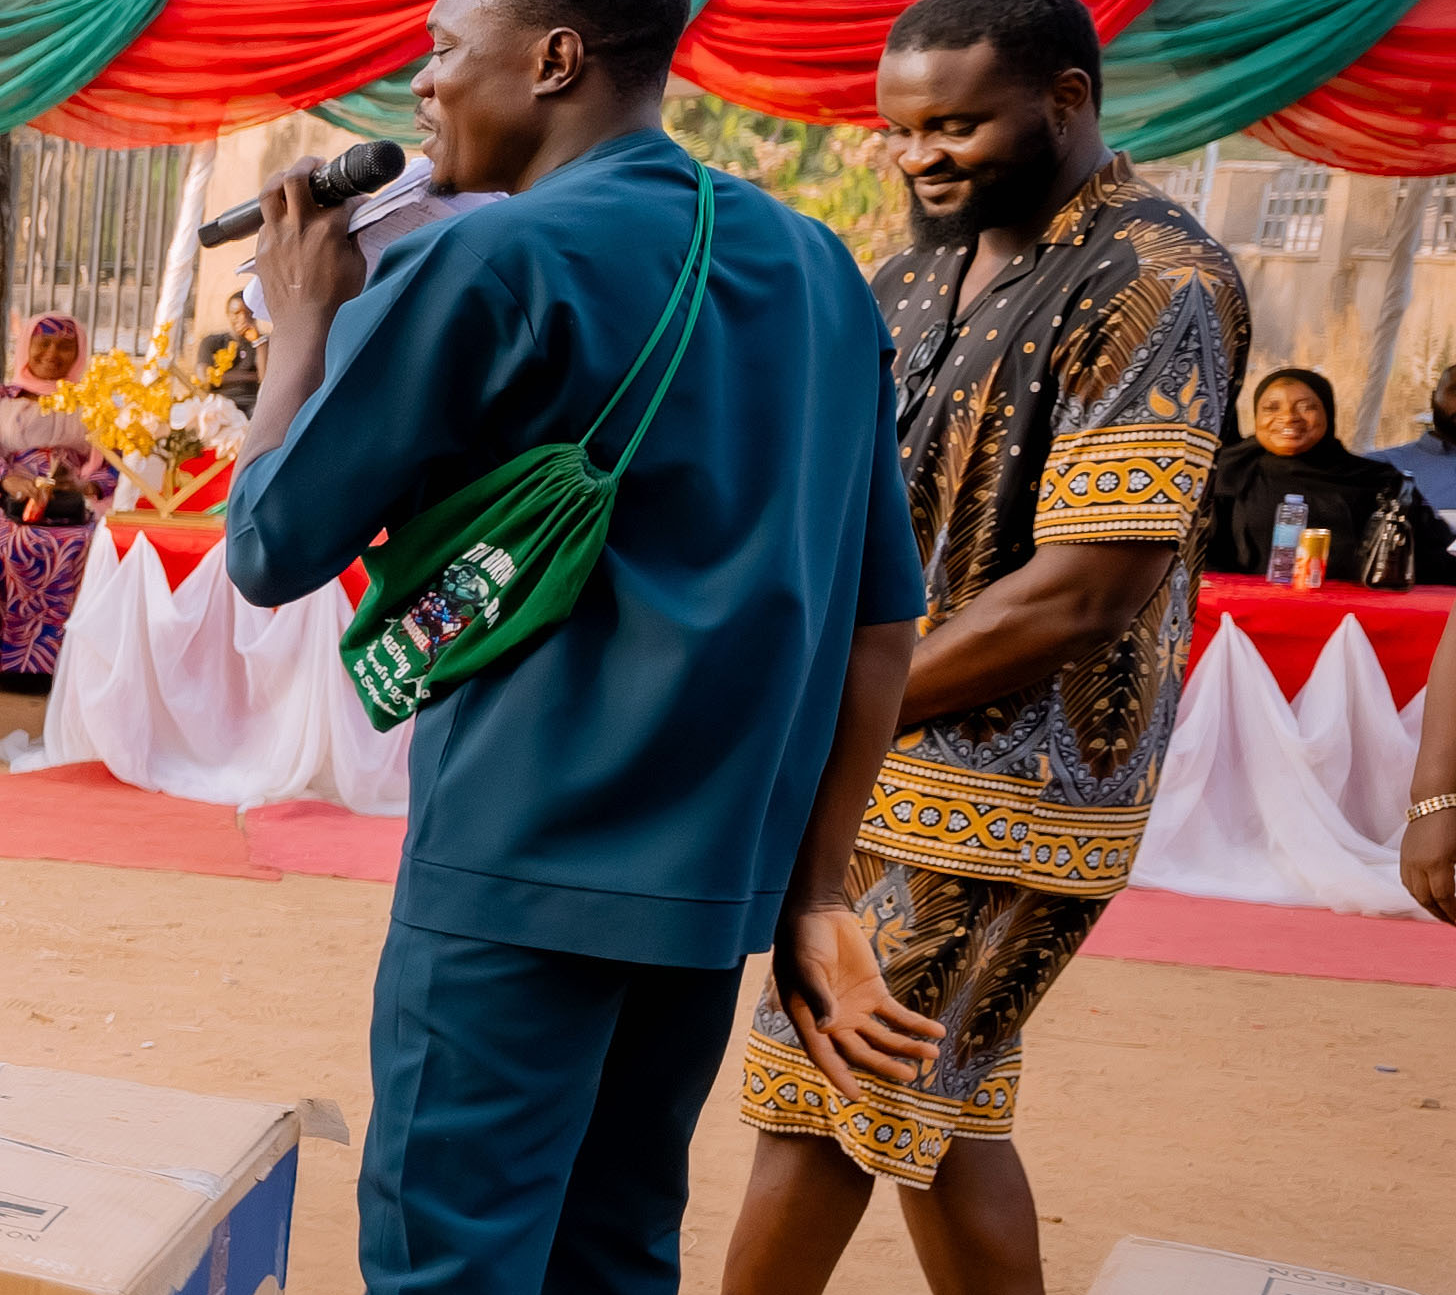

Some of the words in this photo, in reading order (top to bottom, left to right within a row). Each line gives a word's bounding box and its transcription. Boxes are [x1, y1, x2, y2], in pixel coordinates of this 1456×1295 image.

[400, 614, 432, 652] MARVEL
[6, 1229, 41, 1243] ON
[1267, 1266, 1317, 1282] ON
